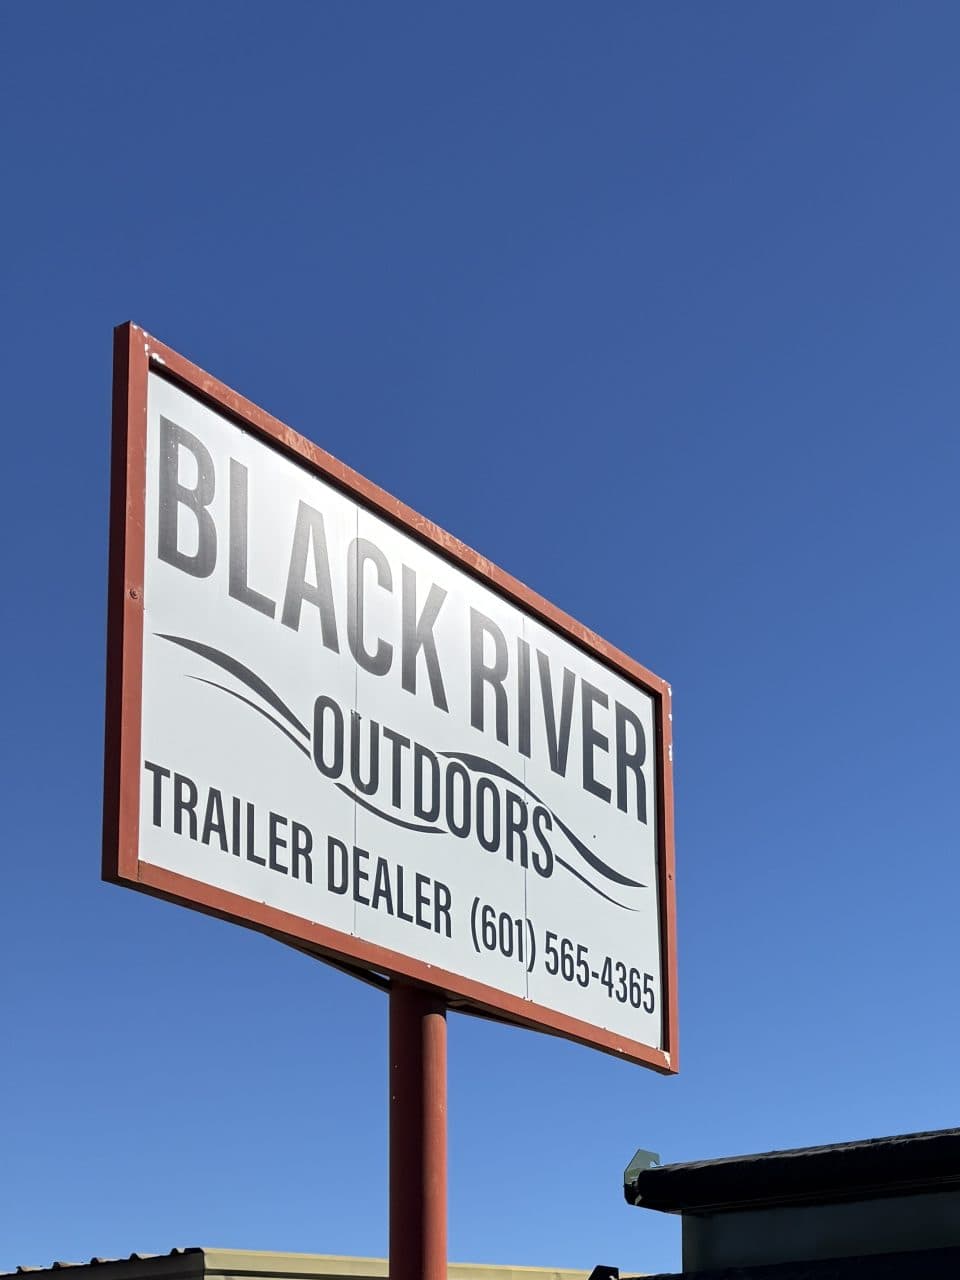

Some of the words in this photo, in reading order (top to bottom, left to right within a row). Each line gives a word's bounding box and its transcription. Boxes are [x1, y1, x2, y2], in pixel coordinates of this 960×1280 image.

[157, 414, 449, 714] BLACK
[470, 606, 647, 825] RIVER
[144, 760, 313, 884] TRAILER
[327, 835, 452, 938] DEALER
[471, 897, 536, 972] (601)
[545, 931, 655, 1014] 565-4365
[313, 695, 554, 878] OUTDOORS
